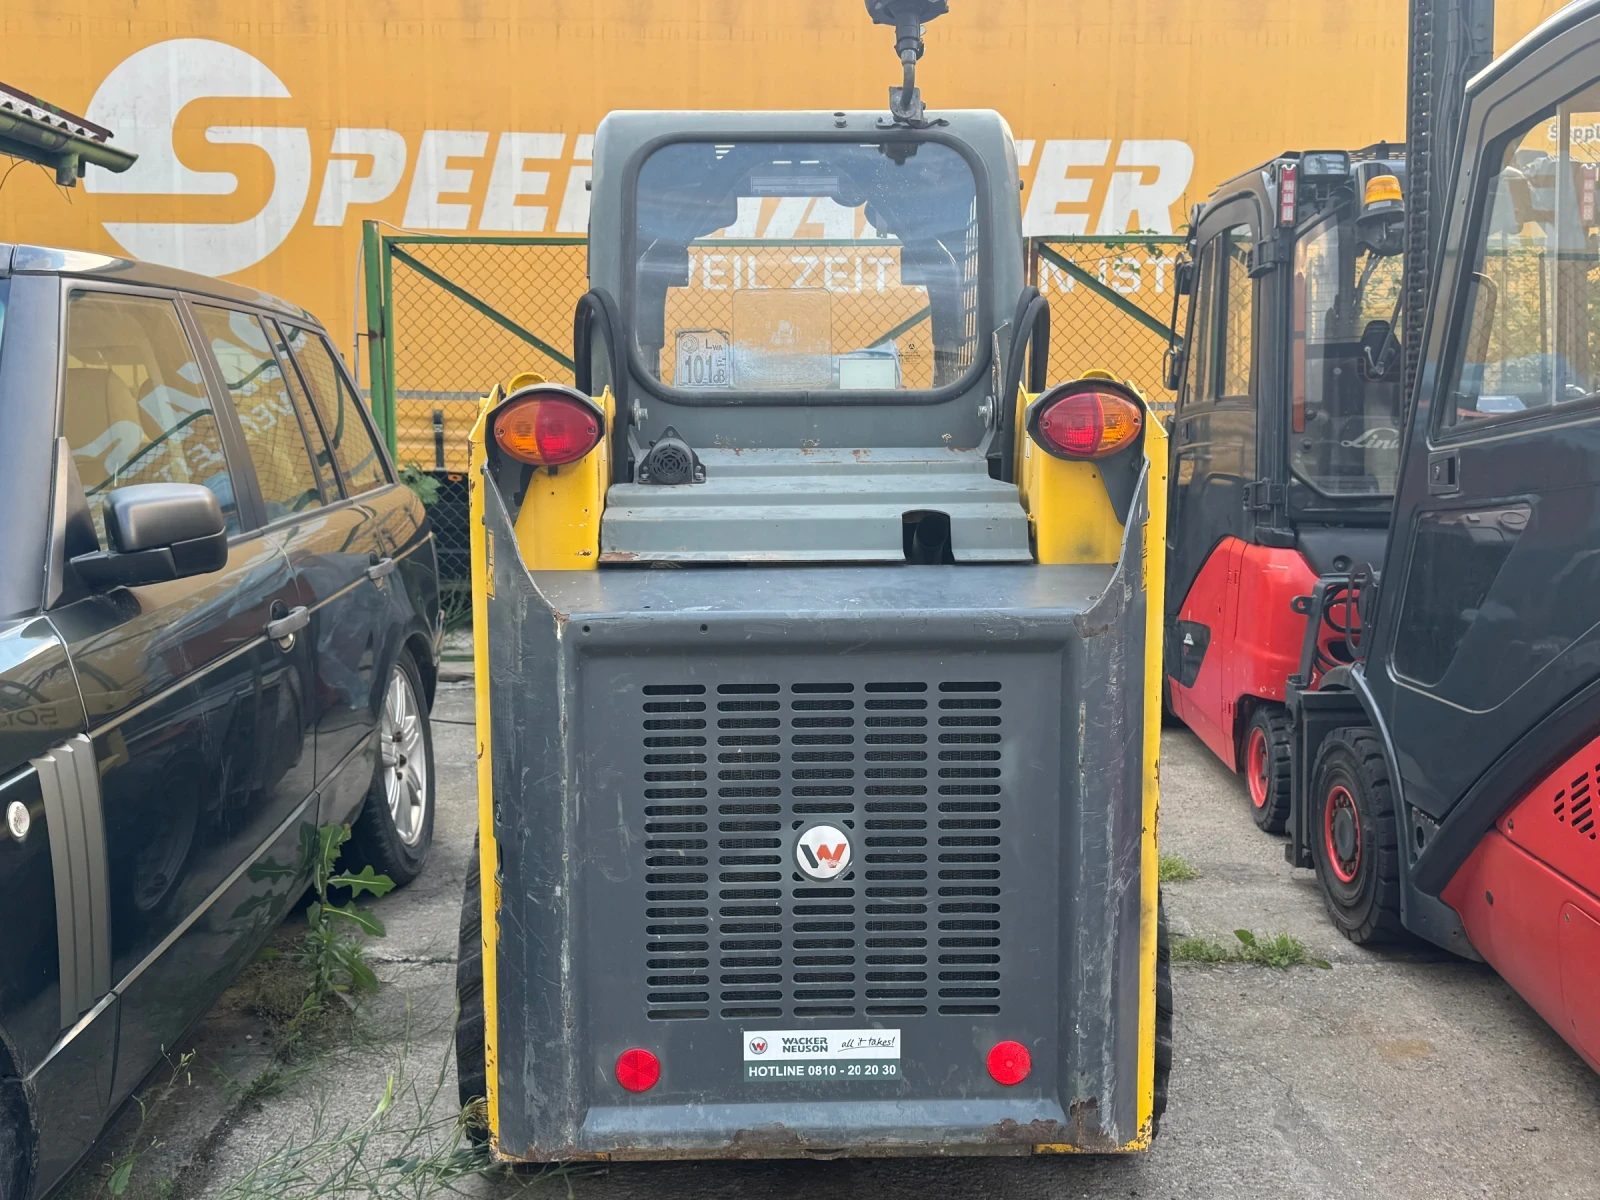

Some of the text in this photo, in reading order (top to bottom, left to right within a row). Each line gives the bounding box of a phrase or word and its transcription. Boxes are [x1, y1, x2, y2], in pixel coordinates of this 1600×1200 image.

[689, 255, 895, 293] EIL ZEIT
[684, 354, 713, 384] 101
[1340, 427, 1399, 449] Lin
[781, 1037, 828, 1045] WACKER
[841, 1036, 896, 1048] all it takes!
[782, 1045, 828, 1053] NEUSON
[748, 1065, 805, 1077] HOTLINE
[807, 1065, 837, 1076] 0810
[847, 1065, 861, 1076] 20
[864, 1064, 879, 1075] 20
[882, 1064, 896, 1075] 30
